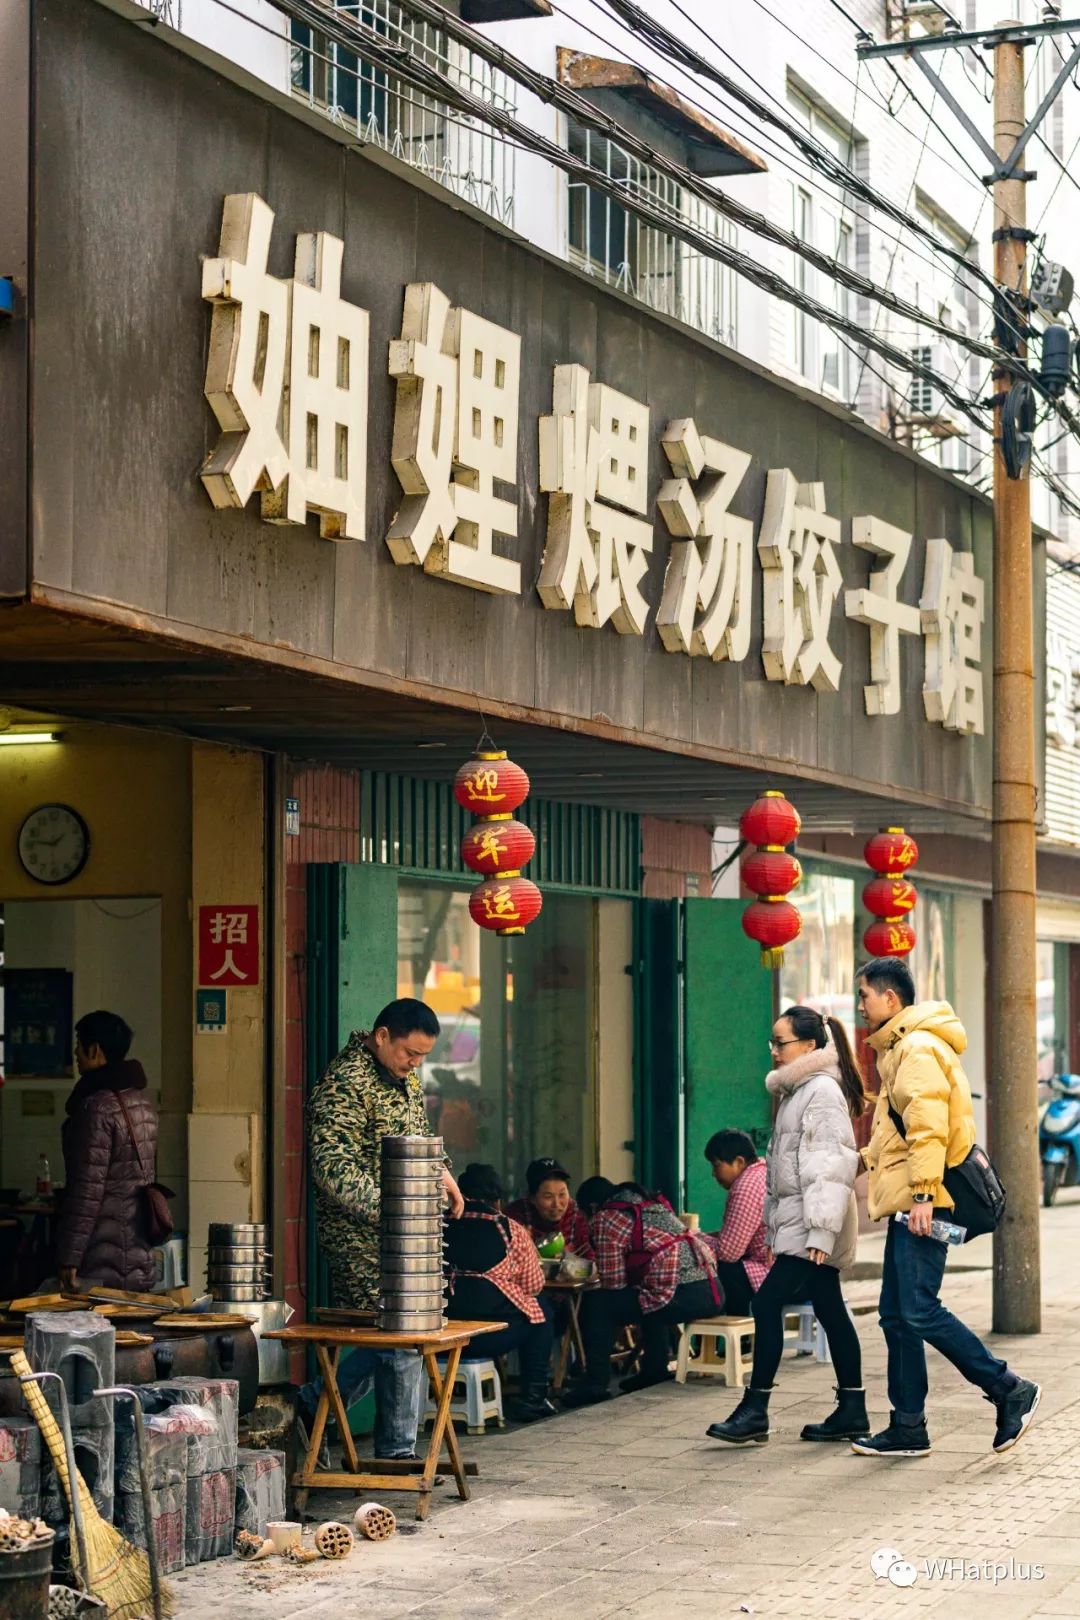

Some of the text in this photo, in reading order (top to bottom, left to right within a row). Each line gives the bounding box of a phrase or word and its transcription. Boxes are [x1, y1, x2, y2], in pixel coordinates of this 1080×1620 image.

[200, 192, 985, 736] 妯娌煨汤饺子馆
[463, 767, 521, 921] 迎军运
[209, 912, 249, 981] 招人
